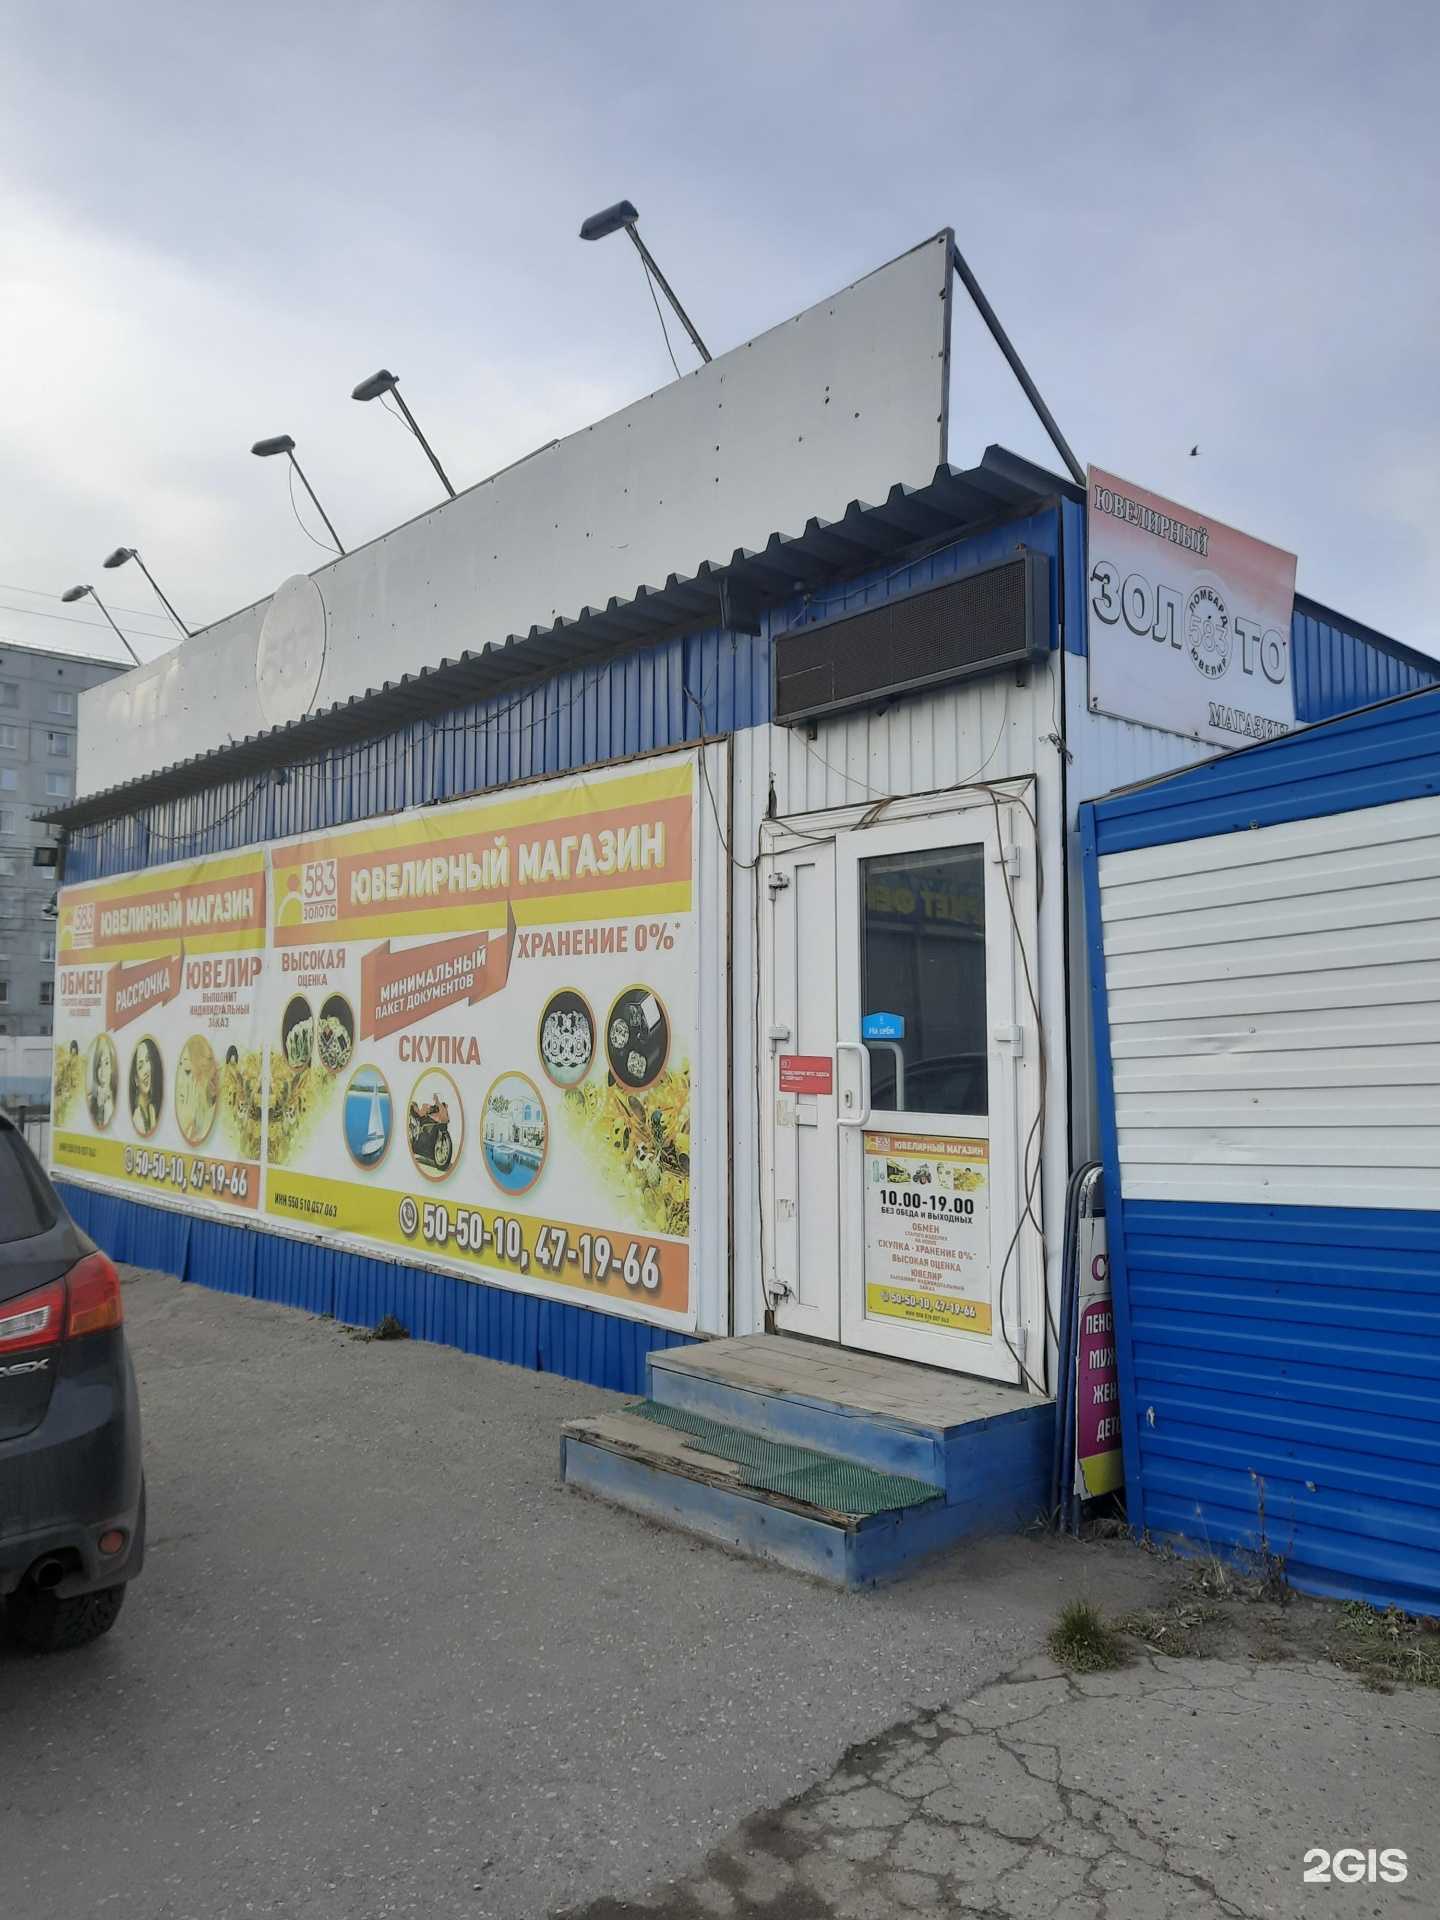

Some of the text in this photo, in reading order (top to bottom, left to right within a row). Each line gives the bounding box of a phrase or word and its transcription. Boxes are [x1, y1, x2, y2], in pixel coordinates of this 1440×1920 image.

[1094, 484, 1210, 557] ЮВЕЛИРНЫЙ
[1189, 589, 1228, 628] ЛОМБАРД
[1190, 615, 1228, 657] 583
[1191, 647, 1228, 677] ЮВЕЛИР
[349, 820, 666, 905] ЮВЕЛИРНЫЙ МАГАЗИН
[304, 860, 336, 899] 583
[101, 887, 254, 937] ЮВЕЛИРНЫЙ МАГАЗИН
[303, 903, 337, 921] ЗОЛОТО
[517, 926, 628, 959] ХРАНЕНИЕ
[186, 955, 263, 990] ЮВЕЛИР
[281, 948, 346, 972] ВЫСОКАЯ
[380, 944, 488, 1003] МИНИМАЛЬНЫЙ
[60, 970, 103, 996] ОБМЕН
[116, 968, 170, 1013] РАССРОЧКА
[297, 973, 328, 987] ОЦЕНКА
[375, 973, 474, 1020] ПАКЕТ ДОКУМЕНТОВ
[398, 1034, 481, 1066] СКУПКА
[133, 1149, 248, 1198] 50-50-10, 47-19-66
[880, 1190, 974, 1214] 10.00-19.00
[881, 1206, 895, 1214] БЕЗ
[895, 1208, 919, 1218] ОБЕДА
[927, 1212, 973, 1224] ВЫХОДНЫХ
[912, 1222, 940, 1234] ОБМЕН
[422, 1203, 660, 1291] 50-50-10, 47-19-66
[878, 1240, 910, 1251] СКУПКА
[915, 1244, 956, 1259] ХРАНЕНИЕ
[892, 1253, 961, 1272] ВЫСОКАЯ ОЦЕНКА
[911, 1269, 943, 1280] ЮВЕЛИР
